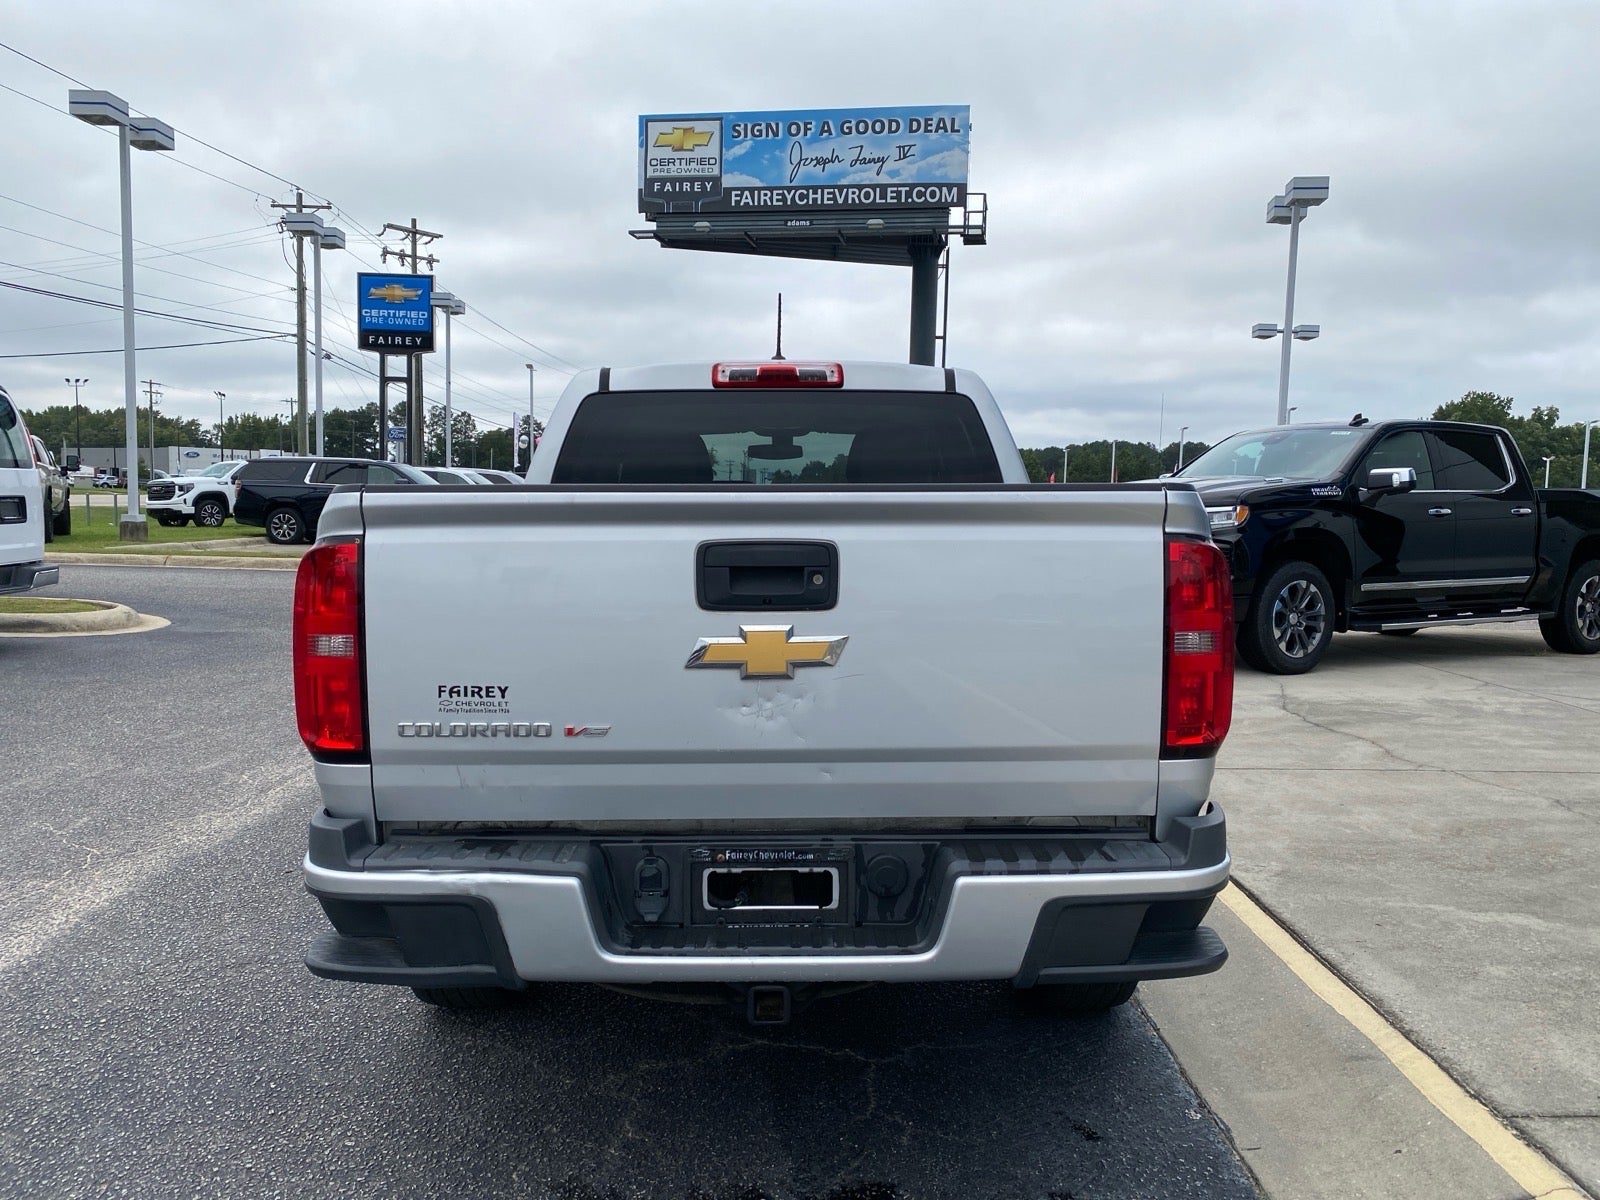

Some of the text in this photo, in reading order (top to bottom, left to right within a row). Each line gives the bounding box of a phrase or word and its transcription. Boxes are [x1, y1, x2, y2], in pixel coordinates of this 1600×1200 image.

[731, 117, 961, 139] SIGN OF A GOOD DEAL
[649, 157, 717, 167] CERTIFIED
[789, 140, 845, 184] Joseph
[893, 143, 917, 162] IV
[653, 181, 713, 192] FAIREY
[731, 186, 958, 207] FAIREYCHEVROLET.COM
[787, 219, 810, 227] adams
[362, 308, 428, 319] CERTIFIED
[368, 335, 422, 345] FAIREY
[437, 685, 509, 699] FAIREY
[397, 722, 552, 738] COLORADO
